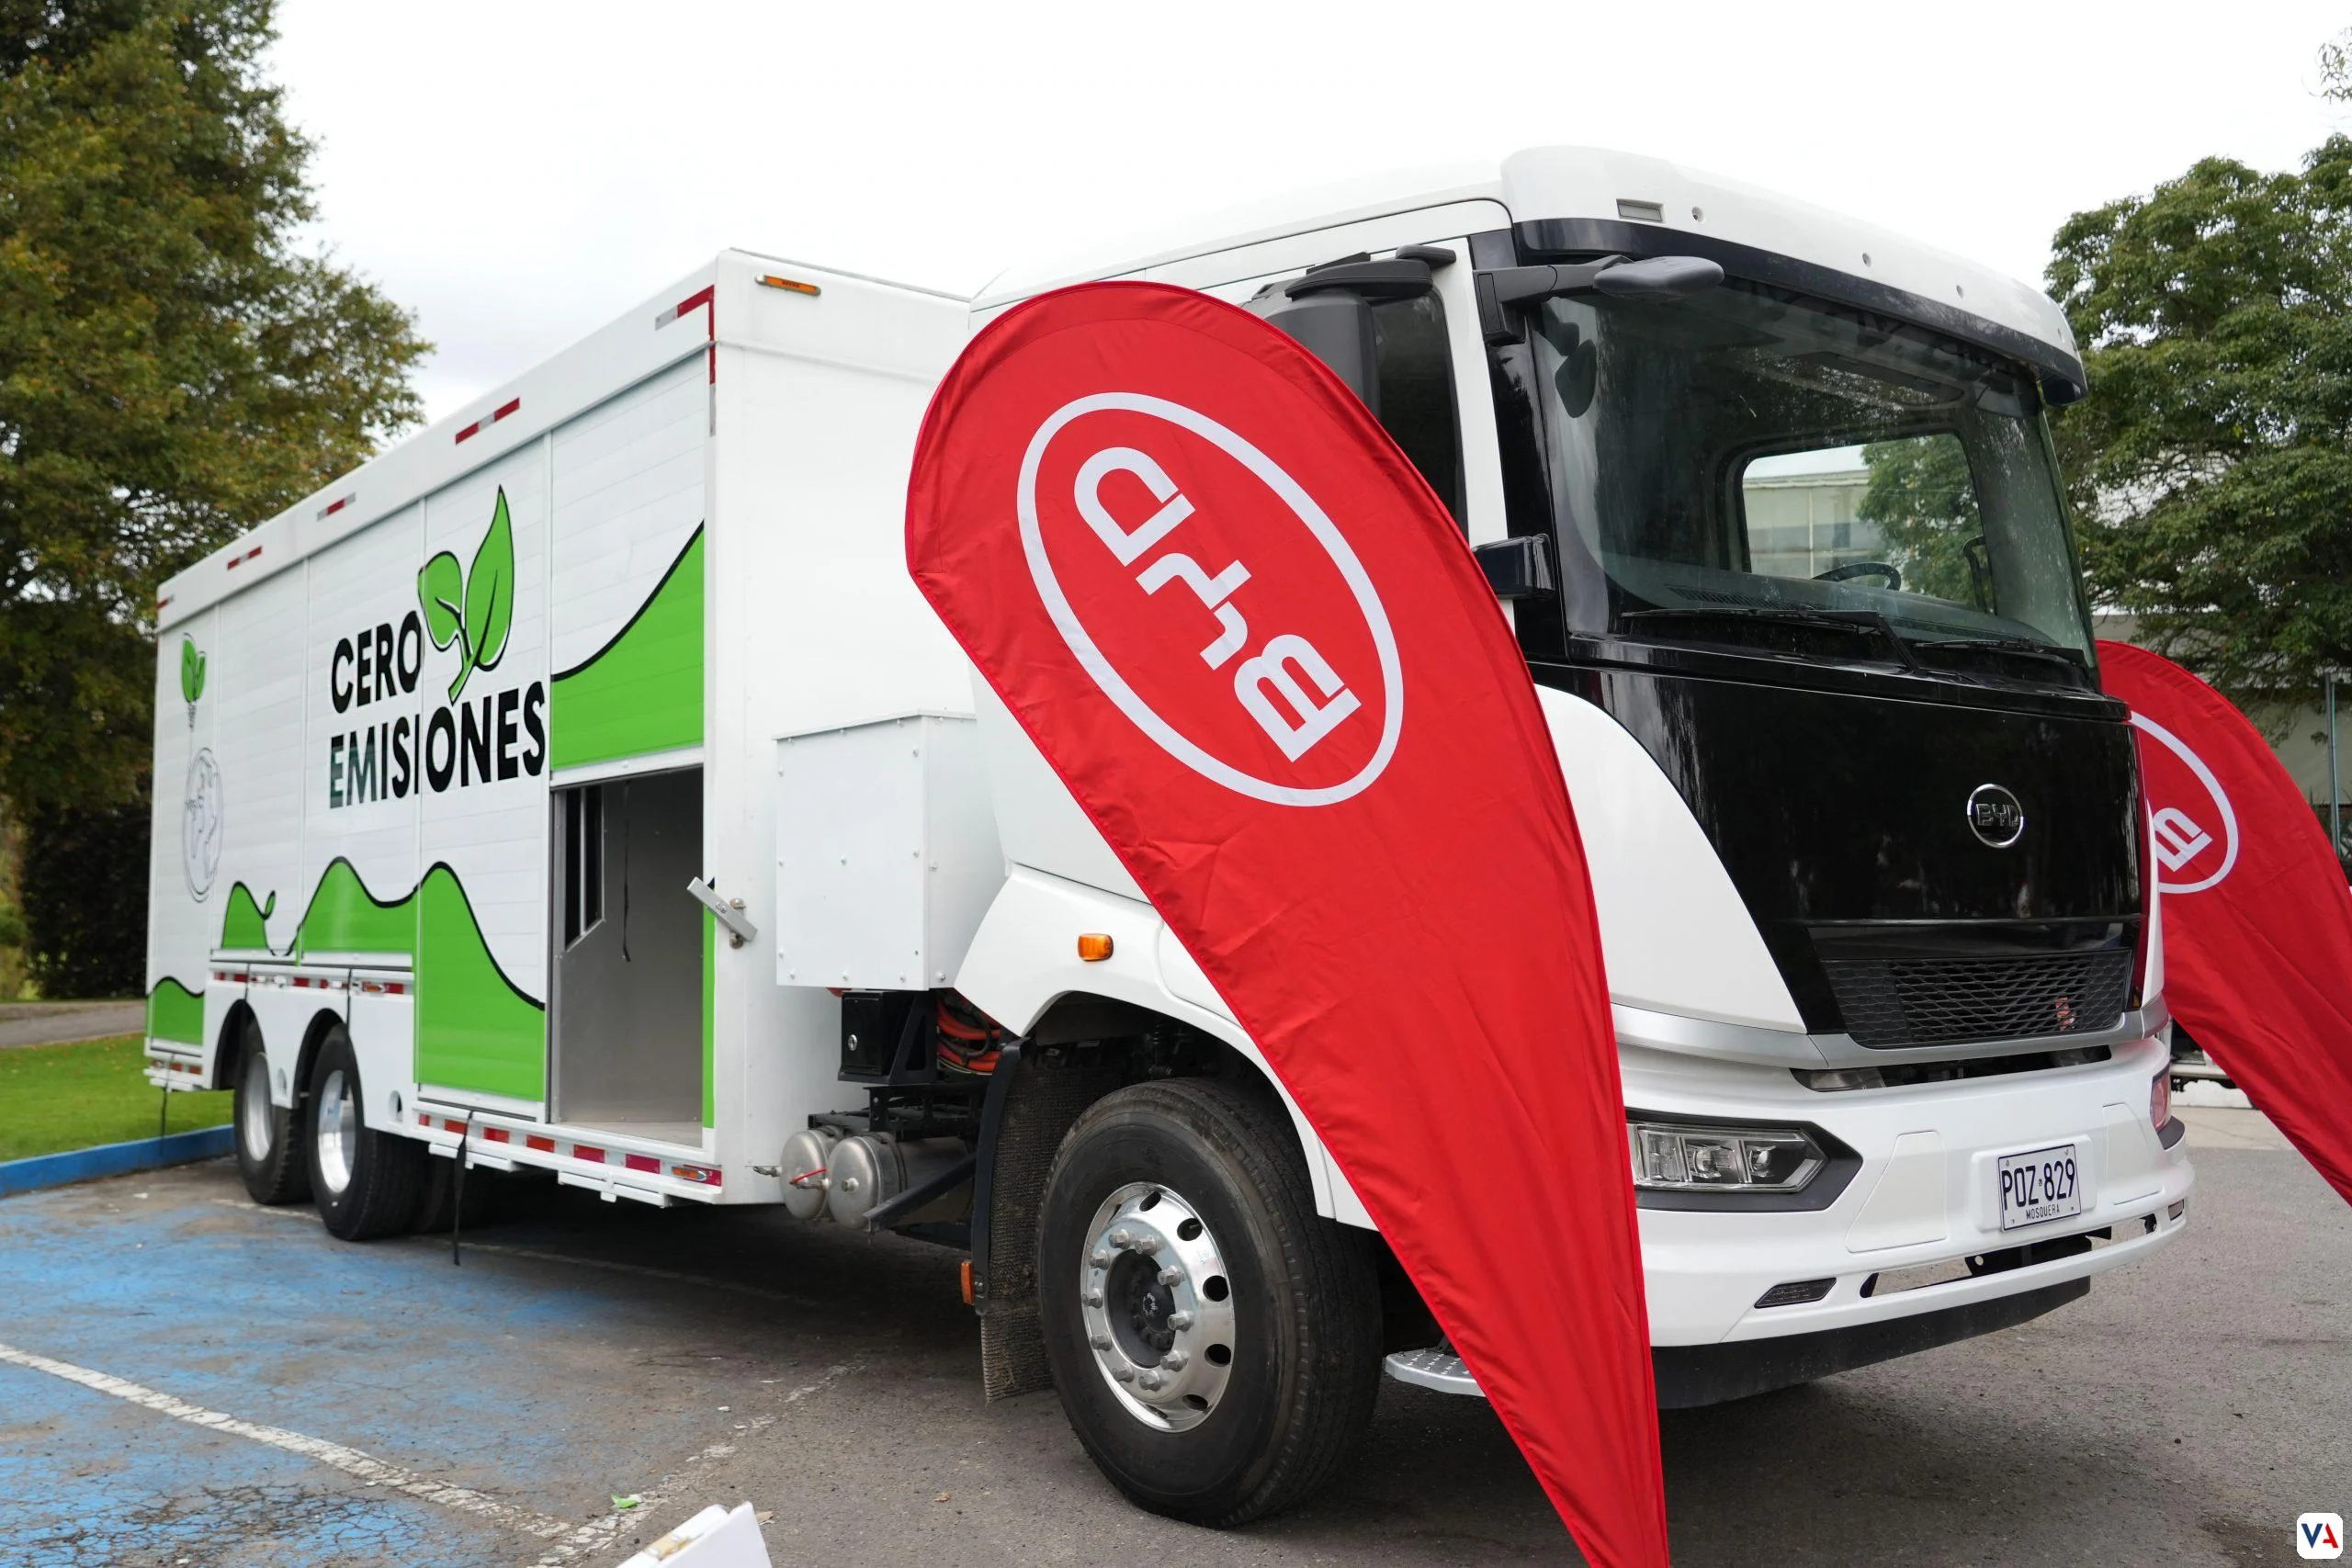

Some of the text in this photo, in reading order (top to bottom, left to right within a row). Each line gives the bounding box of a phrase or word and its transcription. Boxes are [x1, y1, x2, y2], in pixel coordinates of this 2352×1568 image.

[1074, 446, 1362, 762] BYD
[332, 610, 423, 714] CERO
[330, 681, 546, 809] EMISIONES
[1975, 803, 2018, 827] BYD
[2026, 1203, 2060, 1220] MOSQUERA
[2043, 1157, 2075, 1201] 829
